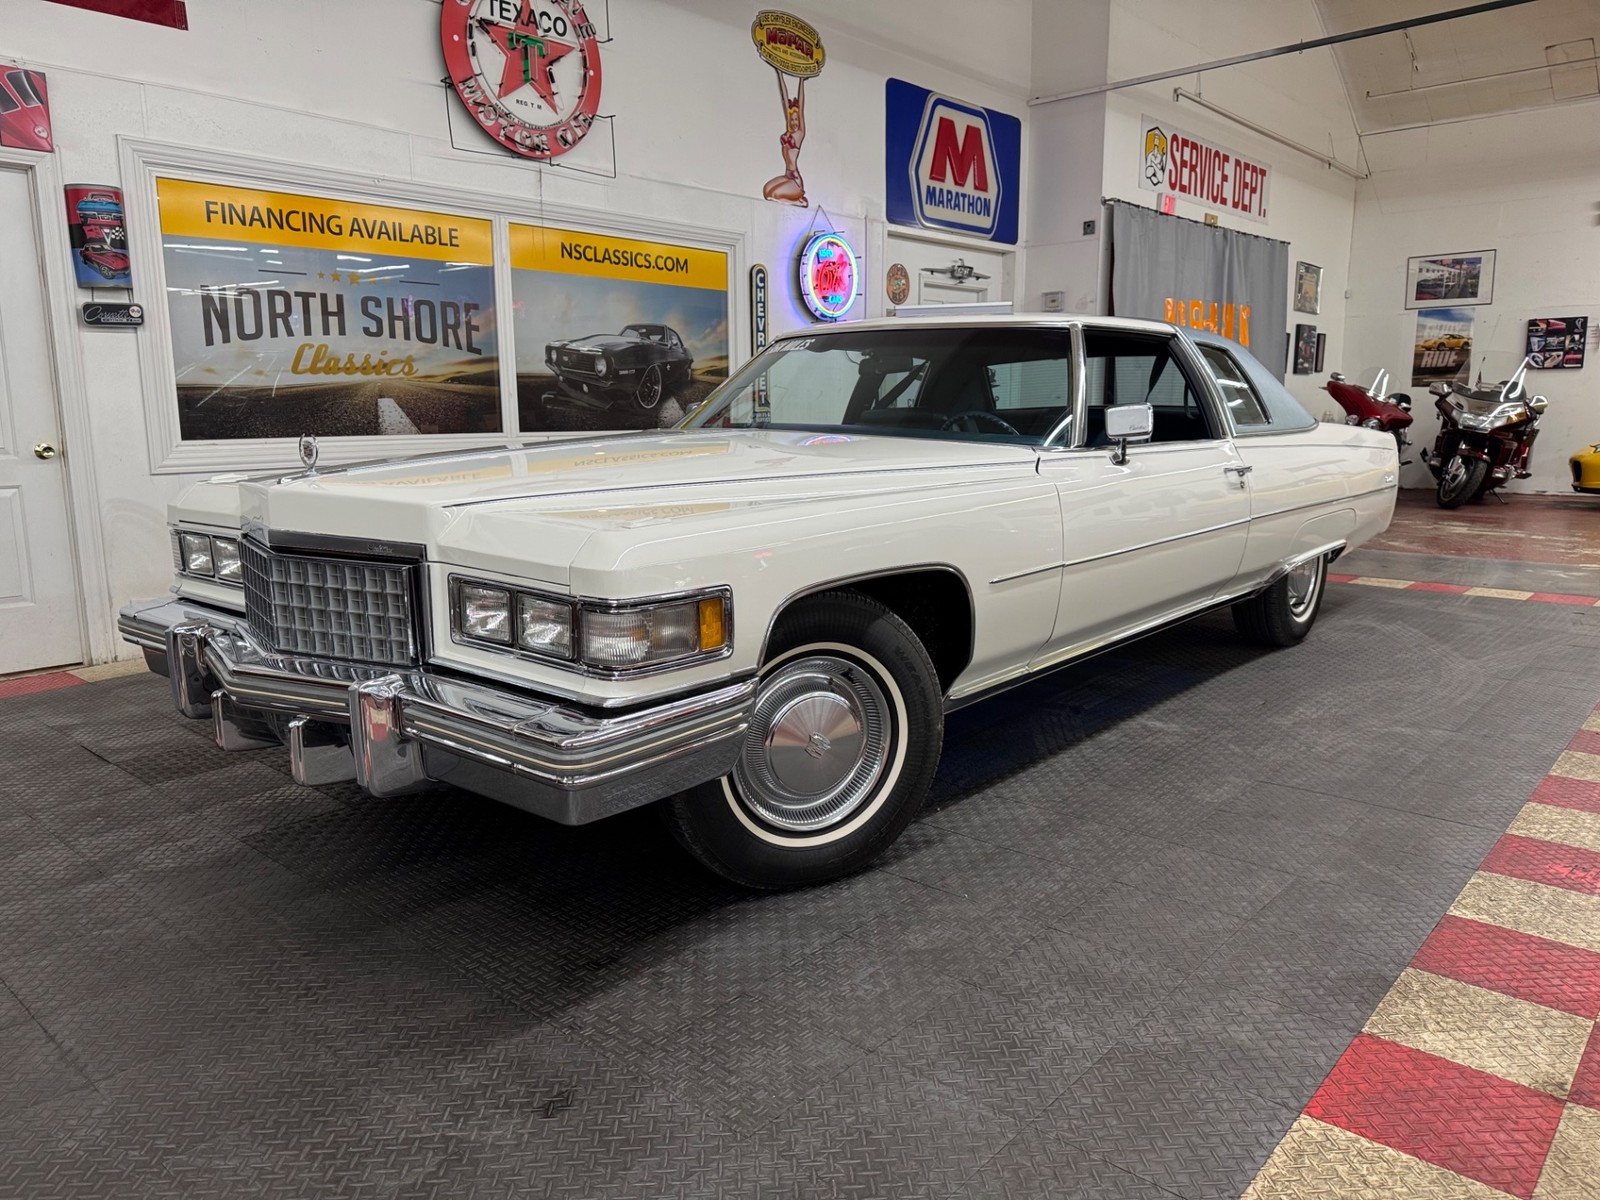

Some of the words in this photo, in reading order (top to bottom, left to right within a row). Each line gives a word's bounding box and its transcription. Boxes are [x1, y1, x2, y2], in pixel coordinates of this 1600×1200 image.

[489, 0, 567, 37] TEXACO
[929, 116, 989, 193] M
[1168, 133, 1230, 206] SERVICE
[1232, 158, 1267, 218] DEPT.
[925, 185, 991, 217] MARATHON
[204, 199, 343, 236] FINANCING
[348, 217, 460, 248] AVAILABLE
[560, 241, 689, 274] NSCLASSICS.COM
[200, 284, 347, 347] NORTH
[359, 295, 483, 356] SHORE
[755, 273, 768, 404] CHEVRET
[290, 342, 419, 377] Classics
[1420, 350, 1458, 368] RIDE
